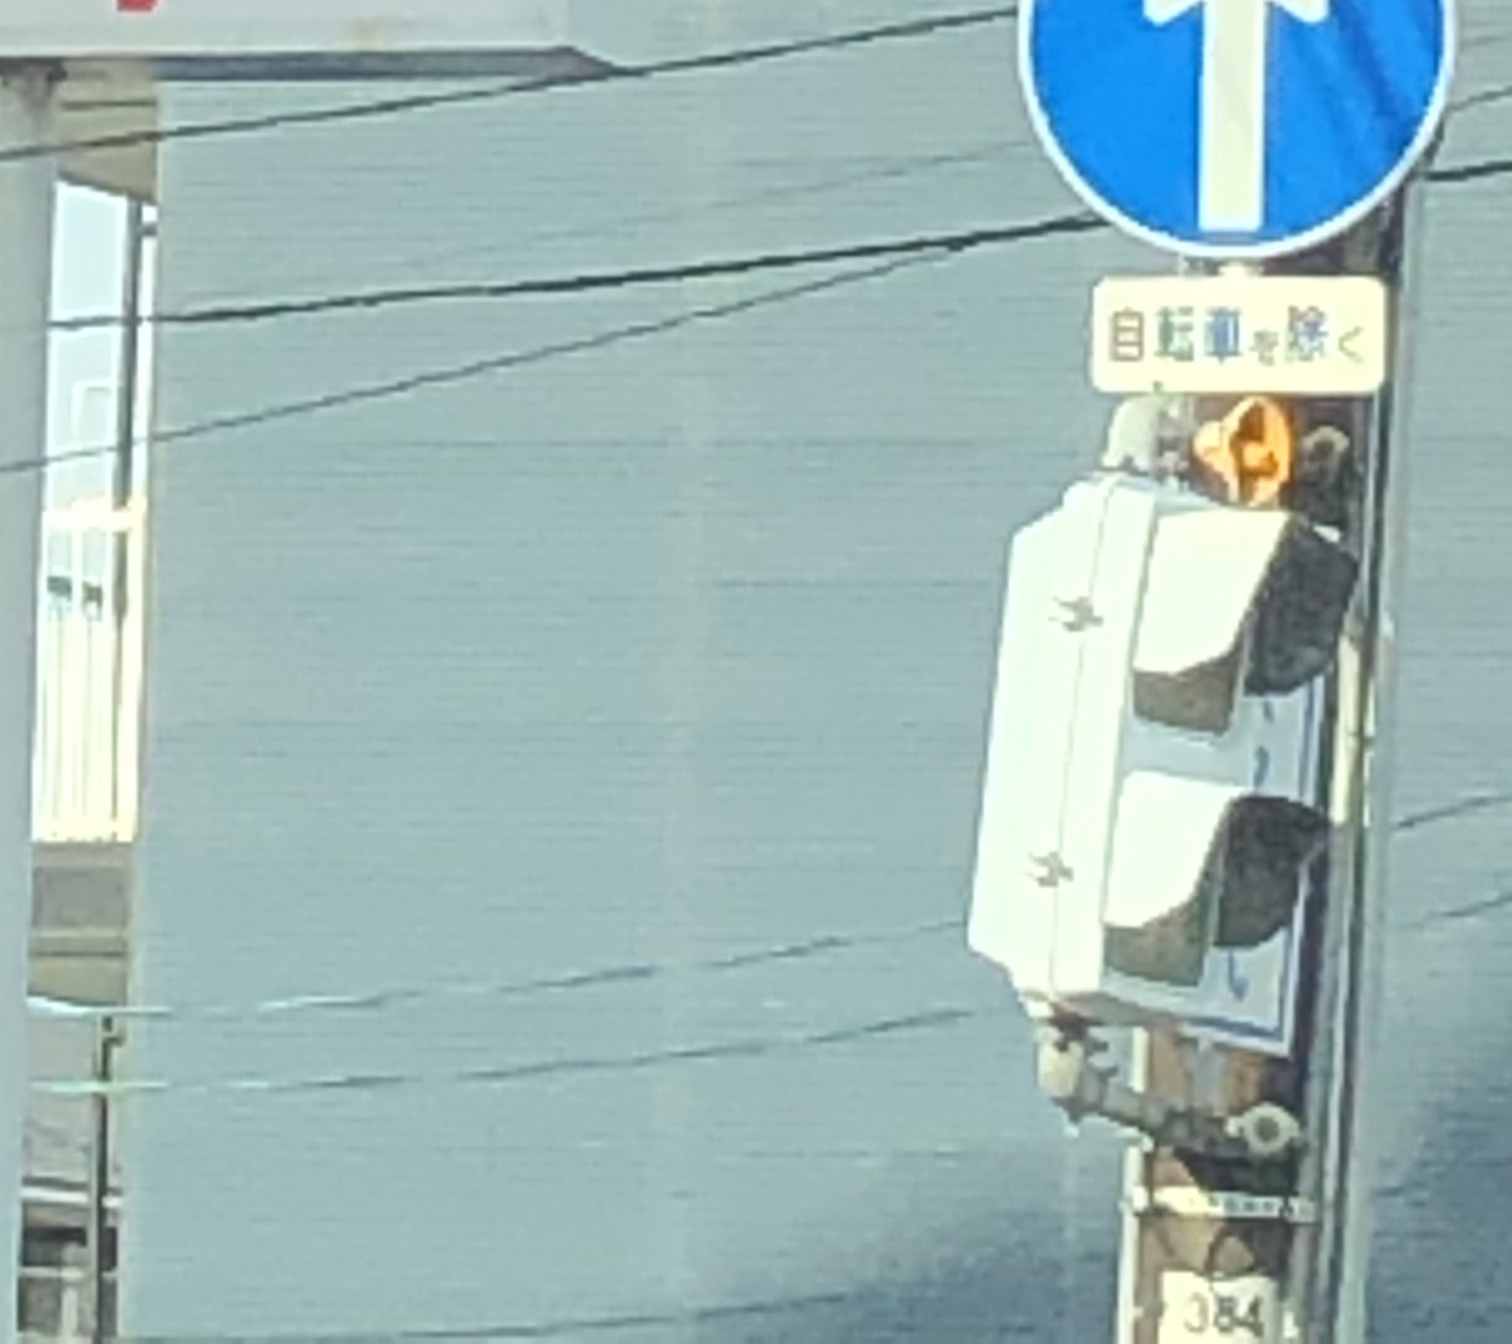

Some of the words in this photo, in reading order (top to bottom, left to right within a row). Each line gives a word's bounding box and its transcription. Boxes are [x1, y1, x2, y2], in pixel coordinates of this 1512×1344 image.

[1109, 305, 1365, 367] 自転車を除く
